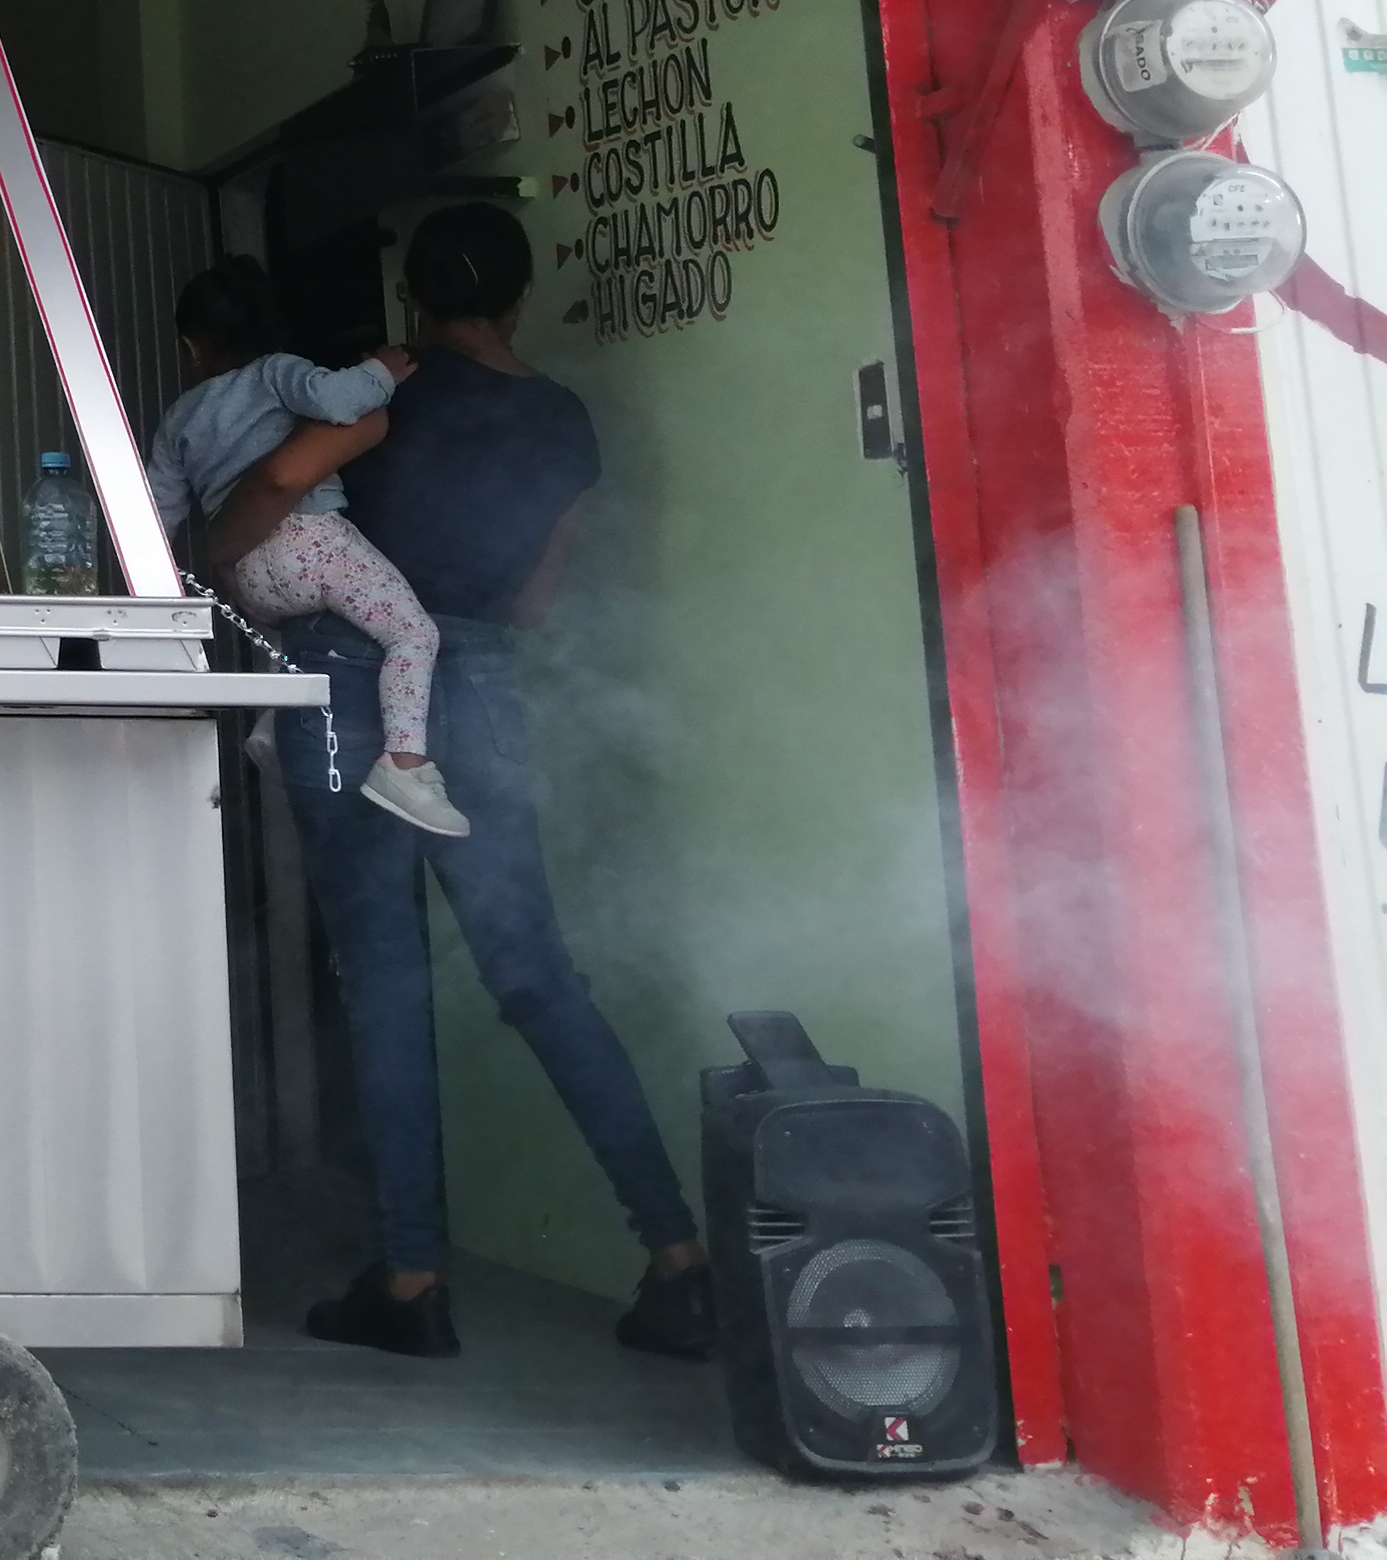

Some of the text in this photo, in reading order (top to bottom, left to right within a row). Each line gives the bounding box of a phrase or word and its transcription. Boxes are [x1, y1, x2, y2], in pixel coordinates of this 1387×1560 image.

[579, 4, 623, 77] AL
[582, 37, 713, 146] LECHON
[582, 103, 748, 209] COSTILLA
[587, 169, 780, 276] CHAMORRO
[594, 250, 734, 342] HIGADO
